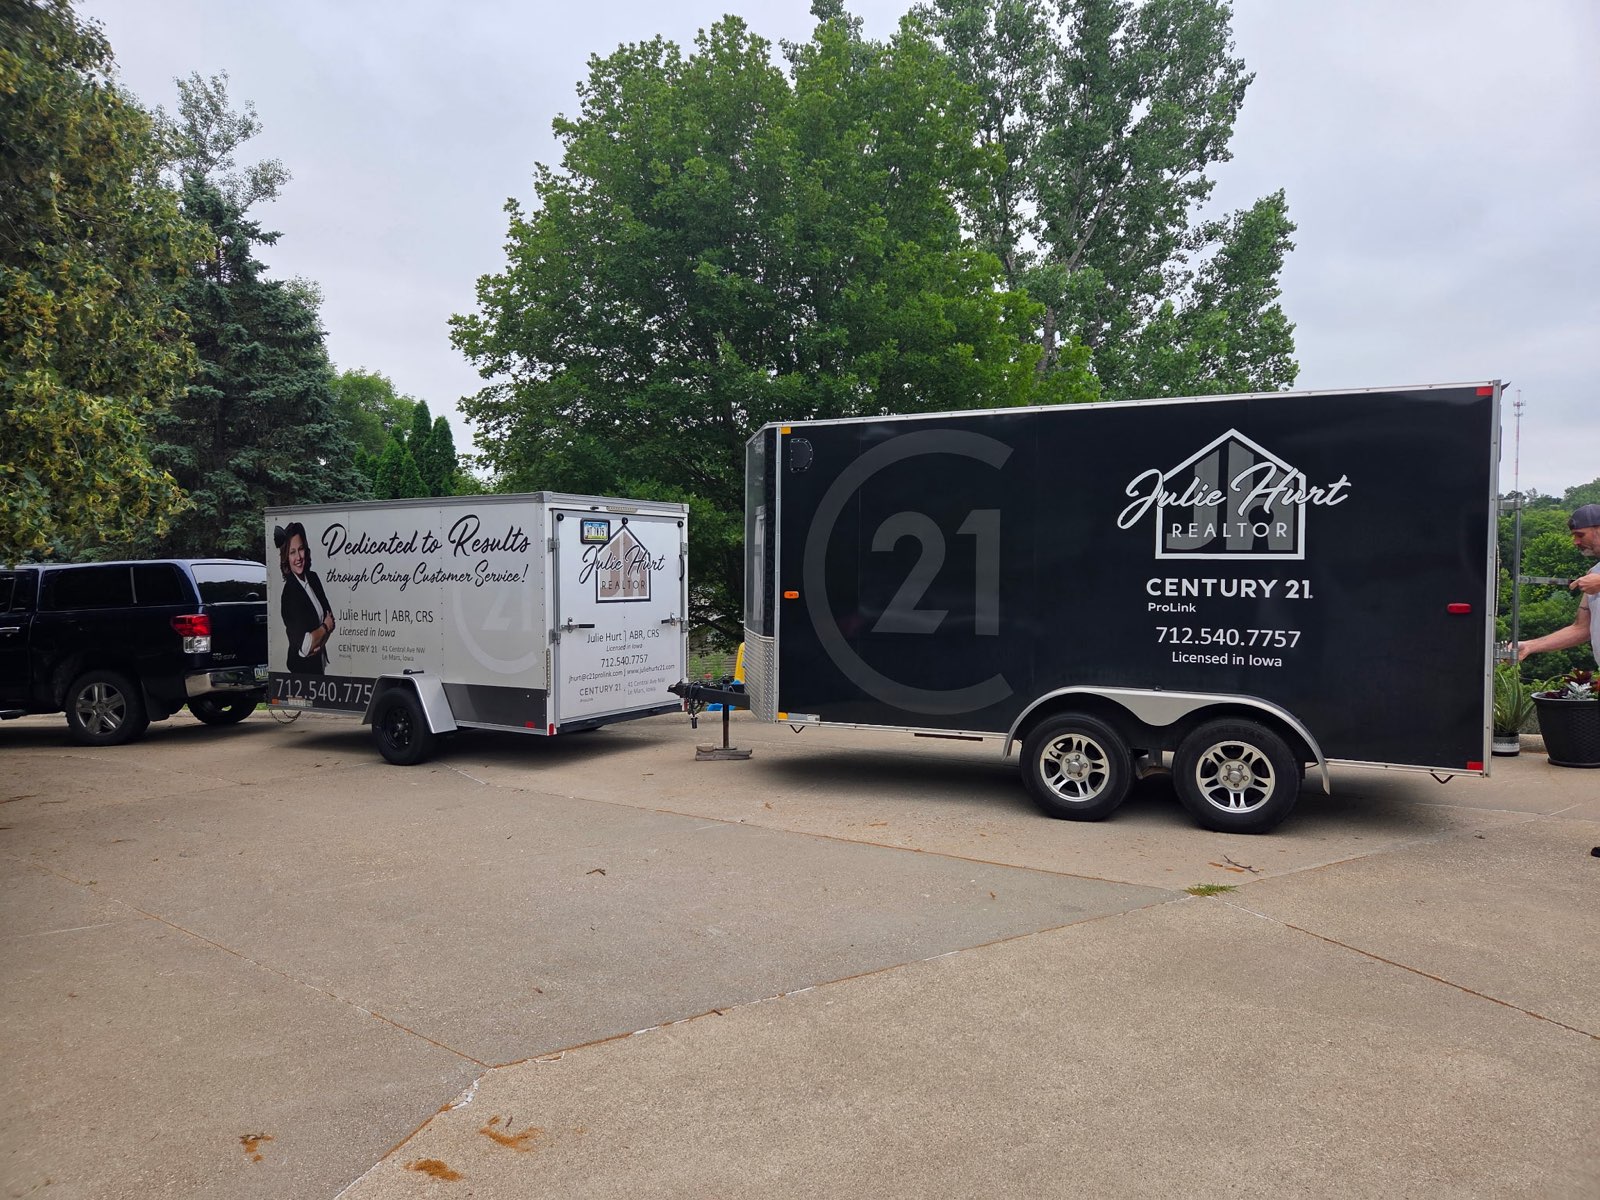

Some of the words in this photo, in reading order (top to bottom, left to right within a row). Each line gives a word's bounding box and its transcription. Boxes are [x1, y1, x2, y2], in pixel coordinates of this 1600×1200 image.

[1117, 468, 1227, 530] Julie
[1230, 461, 1352, 517] Hurt
[321, 522, 418, 559] Dedicated
[422, 530, 442, 554] to
[448, 514, 531, 557] Results
[1172, 522, 1288, 538] REALTOR
[579, 545, 624, 584] Julie
[624, 544, 666, 577] Hurt
[326, 567, 370, 591] through
[370, 562, 412, 591] Caring
[412, 561, 473, 585] Customer
[474, 559, 529, 588] Service!
[601, 580, 646, 590] REALTOR
[1146, 577, 1278, 599] CENTURY
[1148, 602, 1197, 613] ProLink
[339, 609, 359, 621] Julie
[361, 609, 381, 621] Hurt
[391, 610, 413, 624] ABR,
[415, 610, 434, 623] CRS
[339, 627, 369, 637] Licensed
[369, 628, 376, 637] in
[377, 627, 396, 638] Iowa
[587, 632, 604, 644] Julie
[605, 632, 622, 642] Hurt
[629, 629, 646, 641] ABR,
[647, 628, 660, 639] CRS
[1155, 626, 1301, 648] 712.540.7757
[338, 644, 369, 653] CENTURY
[371, 646, 378, 654] 21
[601, 654, 648, 668] 712.540.7757
[1172, 652, 1228, 665] Licensed
[1232, 654, 1245, 666] in
[1249, 654, 1283, 667] Iowa
[579, 684, 614, 697] CENTURY
